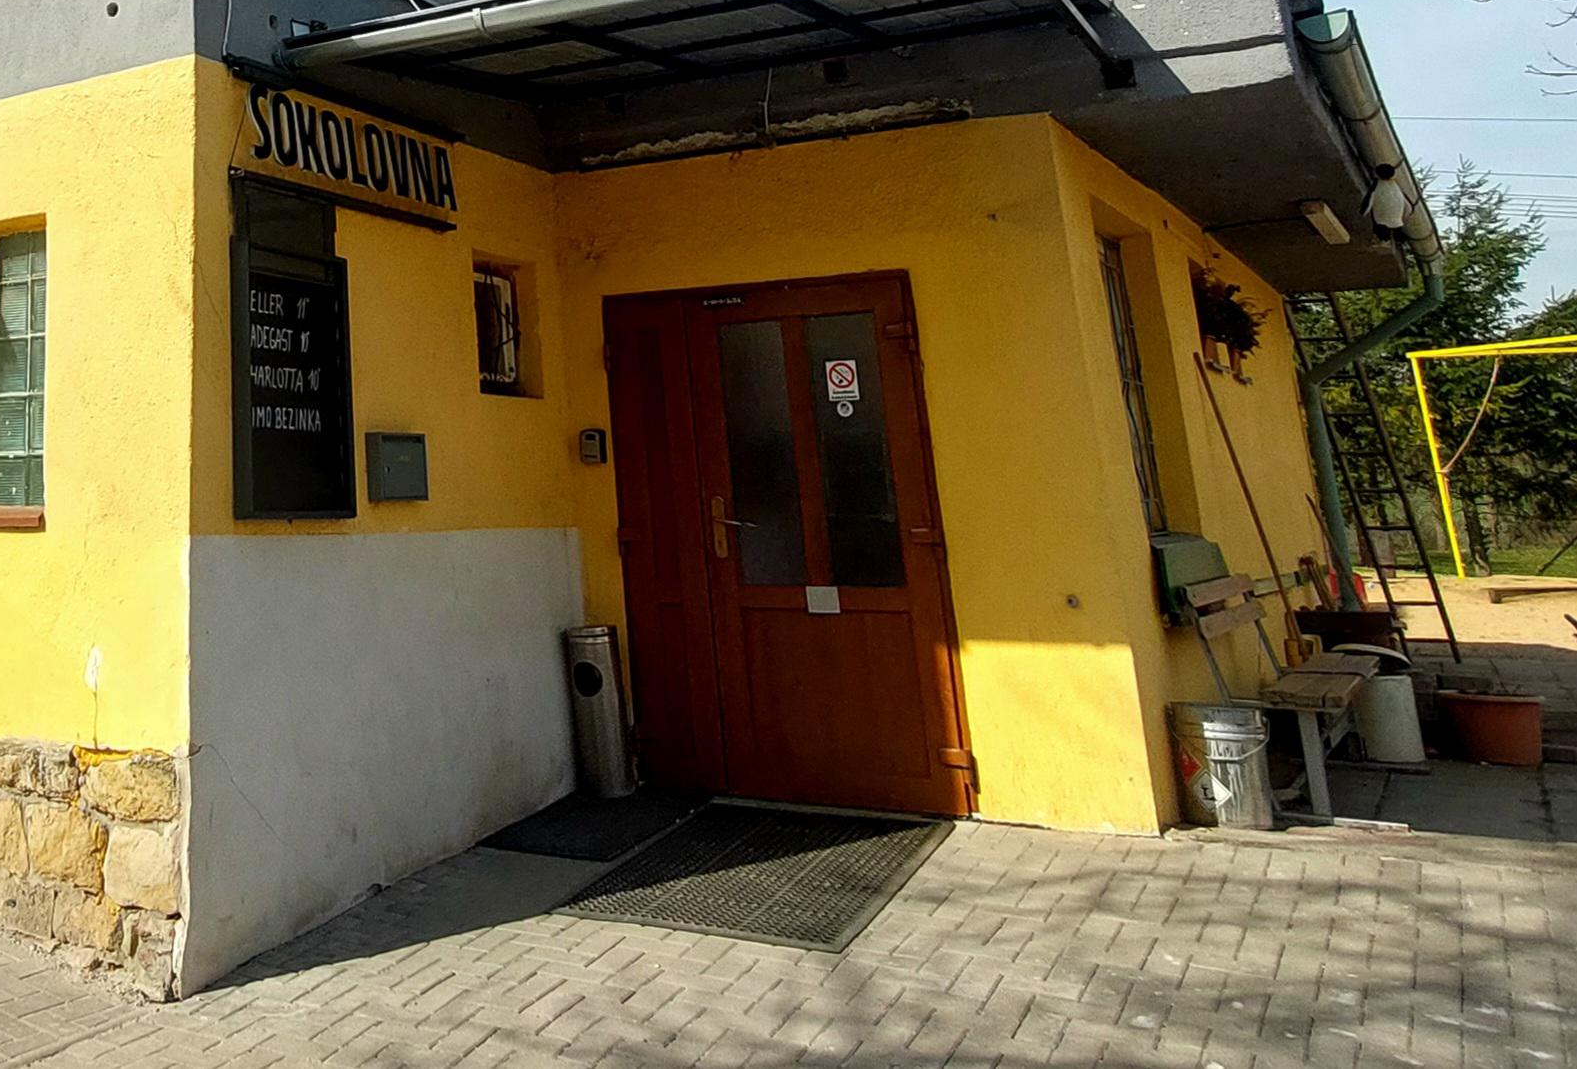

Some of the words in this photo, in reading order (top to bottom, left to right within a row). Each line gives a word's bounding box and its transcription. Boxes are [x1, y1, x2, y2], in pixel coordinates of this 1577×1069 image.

[246, 83, 459, 212] SOKOLOVNA
[250, 289, 284, 316] ELLER
[250, 323, 294, 352] ADEGAST
[250, 364, 303, 393] HARLOTTA
[251, 405, 272, 428] IMO
[274, 407, 322, 432] BEZINKA
